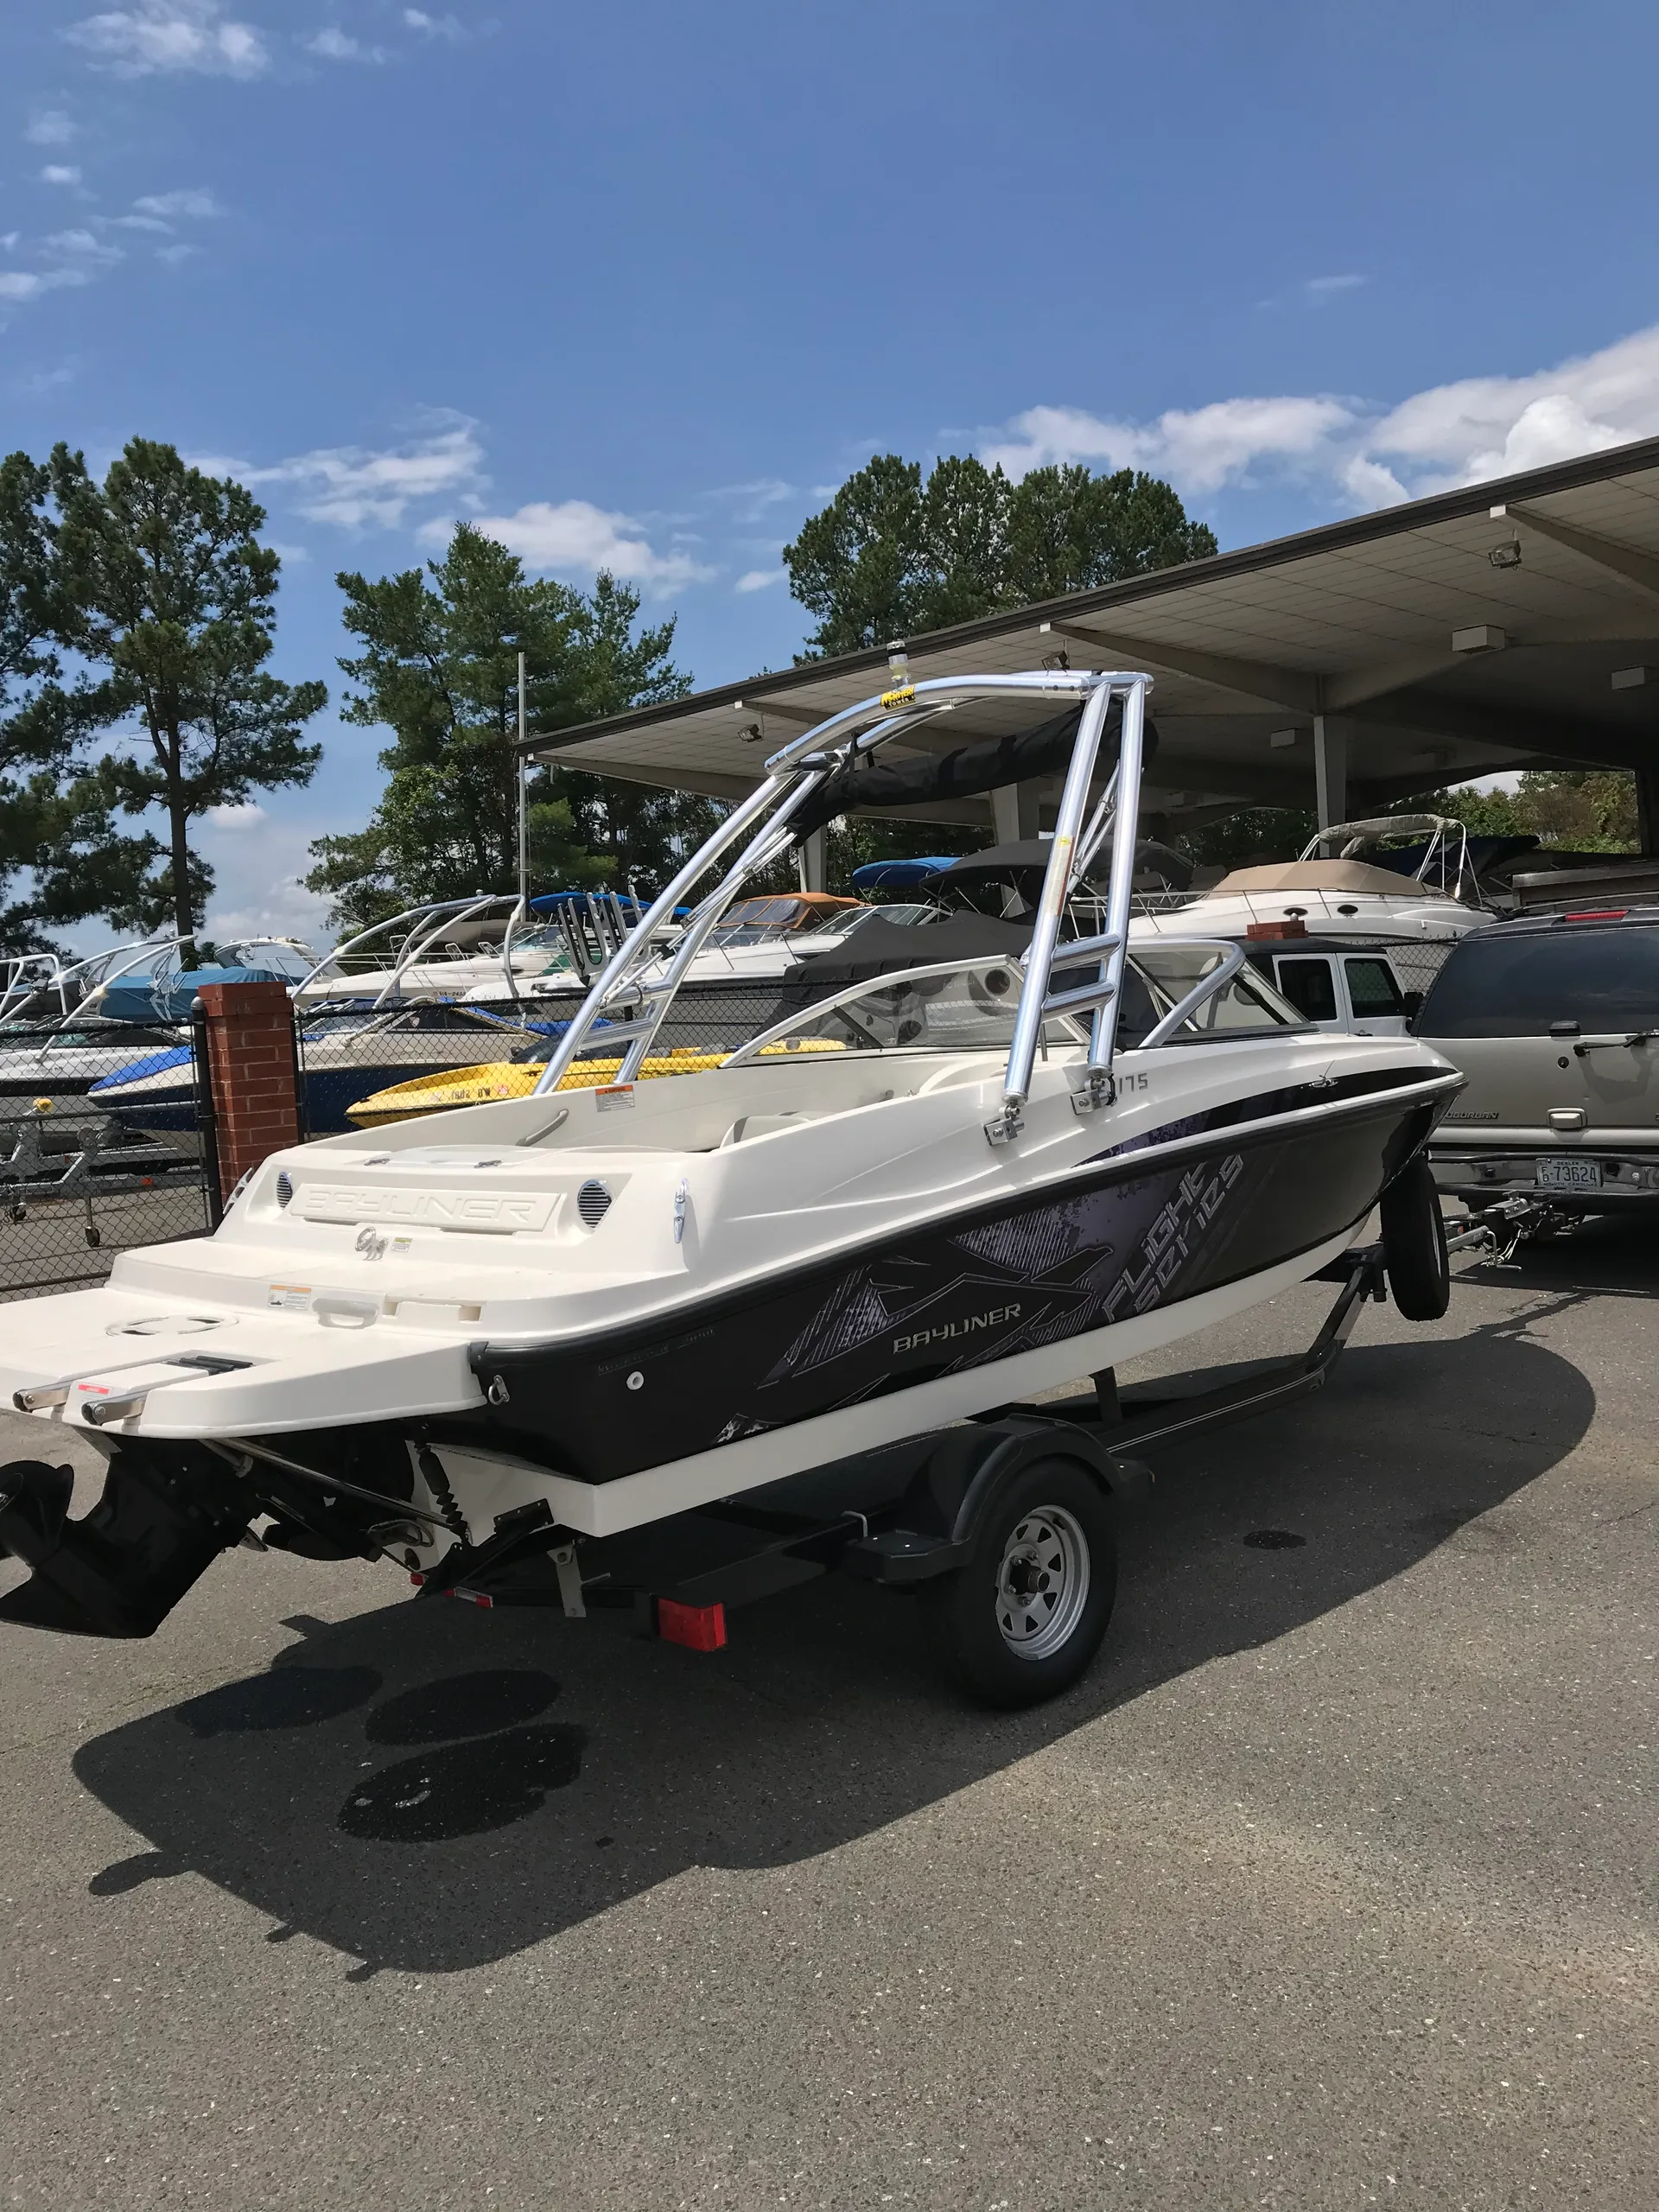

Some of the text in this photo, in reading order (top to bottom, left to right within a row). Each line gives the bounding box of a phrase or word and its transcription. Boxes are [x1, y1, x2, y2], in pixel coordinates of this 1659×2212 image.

[1119, 1073, 1148, 1095] 175
[1445, 1111, 1499, 1120] UBURBAN
[305, 1190, 537, 1223] BAYLINER
[893, 1303, 1021, 1354] BAYLINER
